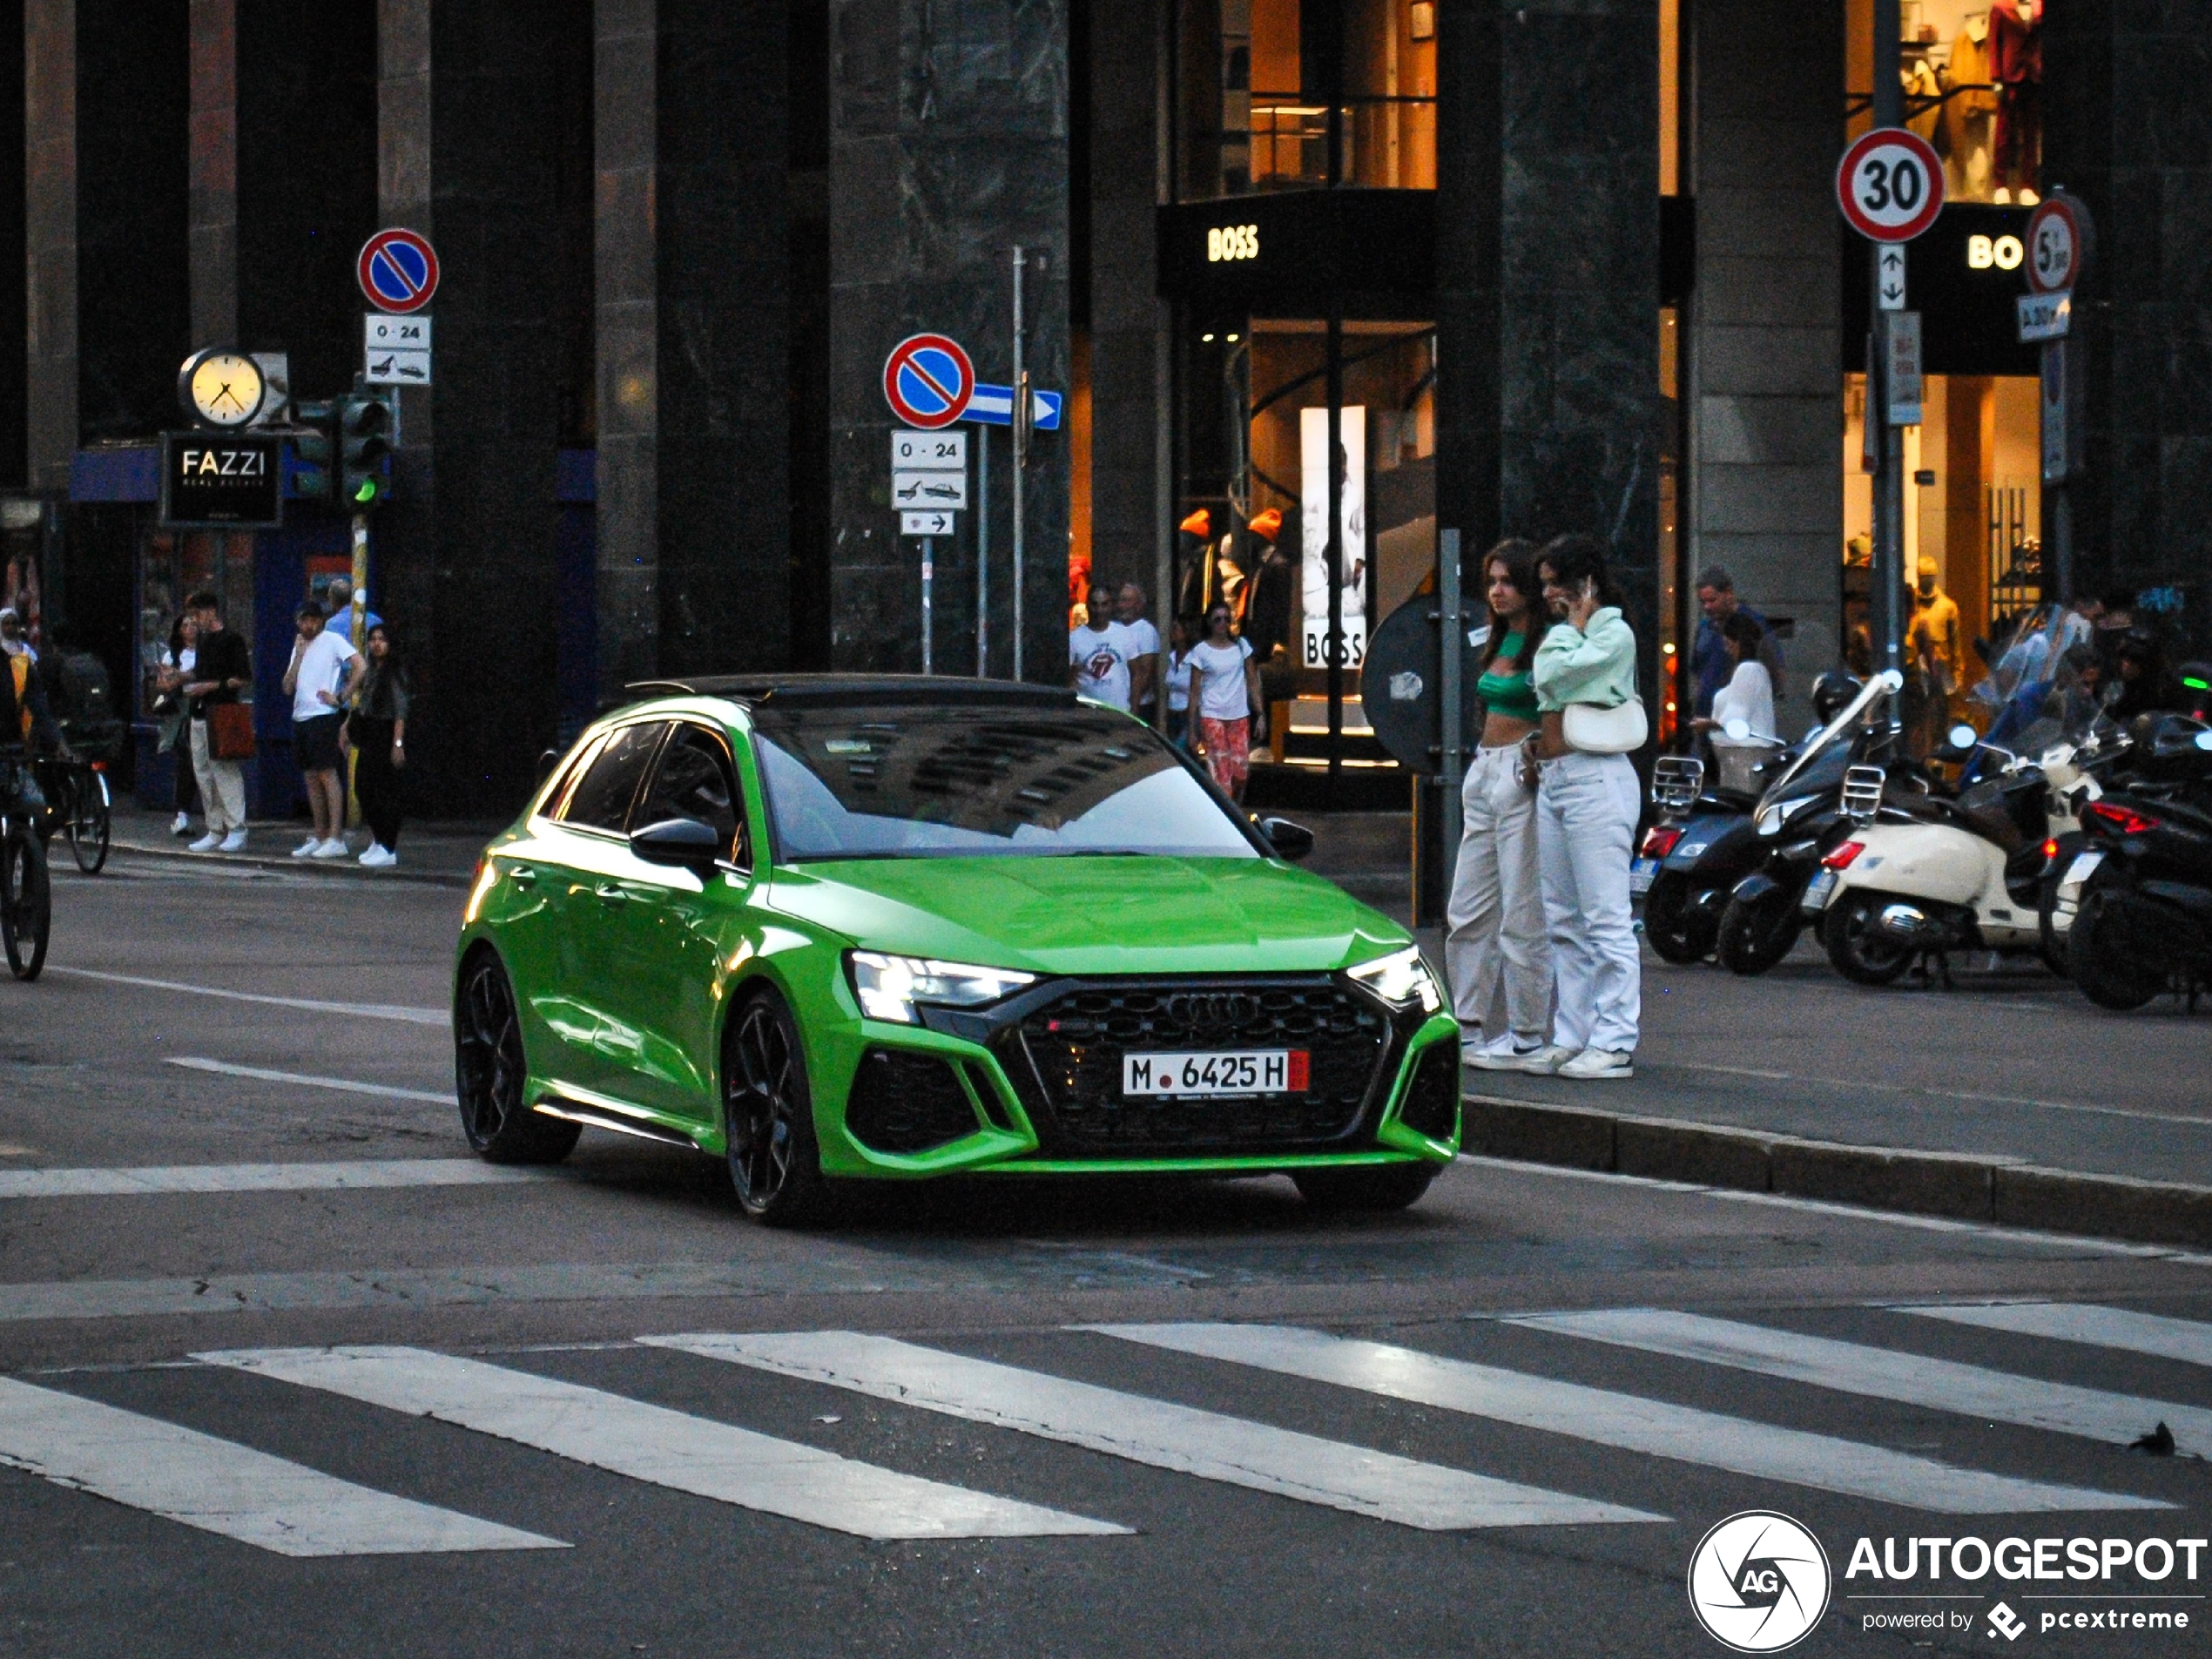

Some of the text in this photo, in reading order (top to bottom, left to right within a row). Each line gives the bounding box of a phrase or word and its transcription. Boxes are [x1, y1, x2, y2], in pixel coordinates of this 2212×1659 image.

[1864, 159, 1921, 211] 30
[1208, 225, 1258, 261] BOSS
[377, 326, 388, 337] 0
[401, 326, 420, 339] 24
[183, 451, 264, 475] FAZZI
[900, 442, 913, 457] 0
[935, 442, 957, 457] 24
[1132, 1059, 1150, 1089] M
[1182, 1057, 1257, 1088] 6425
